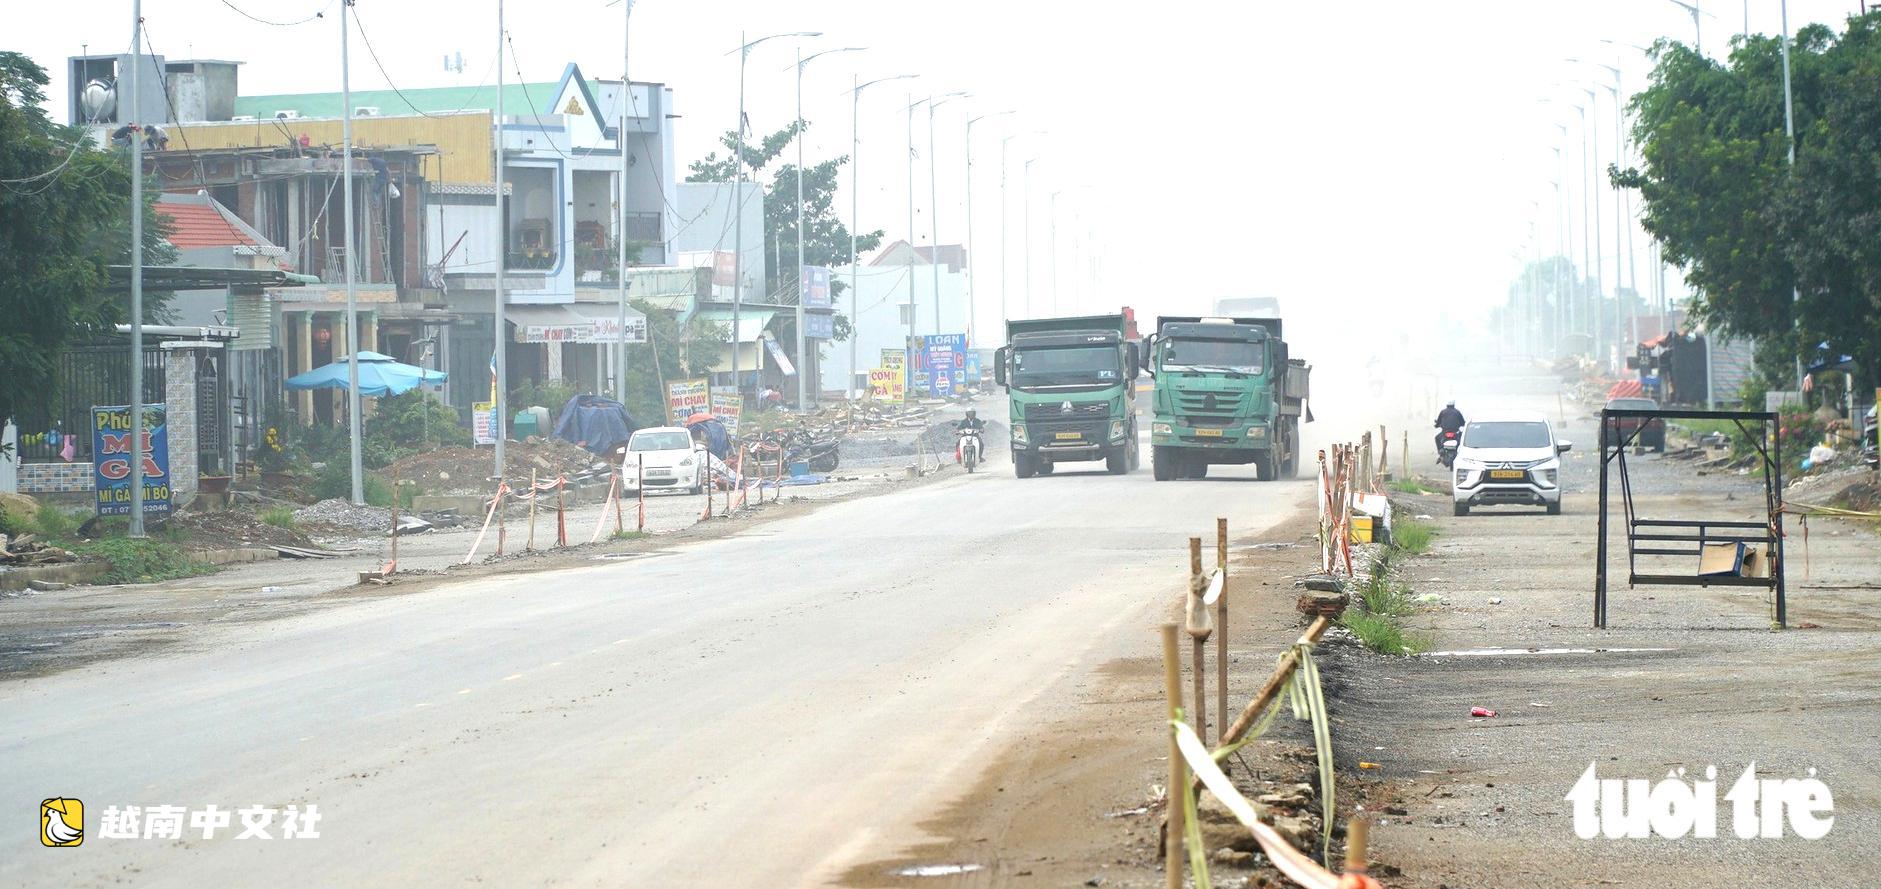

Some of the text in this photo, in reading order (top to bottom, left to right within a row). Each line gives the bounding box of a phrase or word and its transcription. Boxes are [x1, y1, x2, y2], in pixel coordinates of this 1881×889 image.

[929, 335, 960, 345] LOAN
[684, 394, 706, 406] CHAY
[722, 407, 739, 416] CHAY
[99, 453, 165, 479] GÀ
[99, 486, 112, 503] MÌ
[115, 484, 131, 502] GÀ
[153, 482, 169, 500] BÒ
